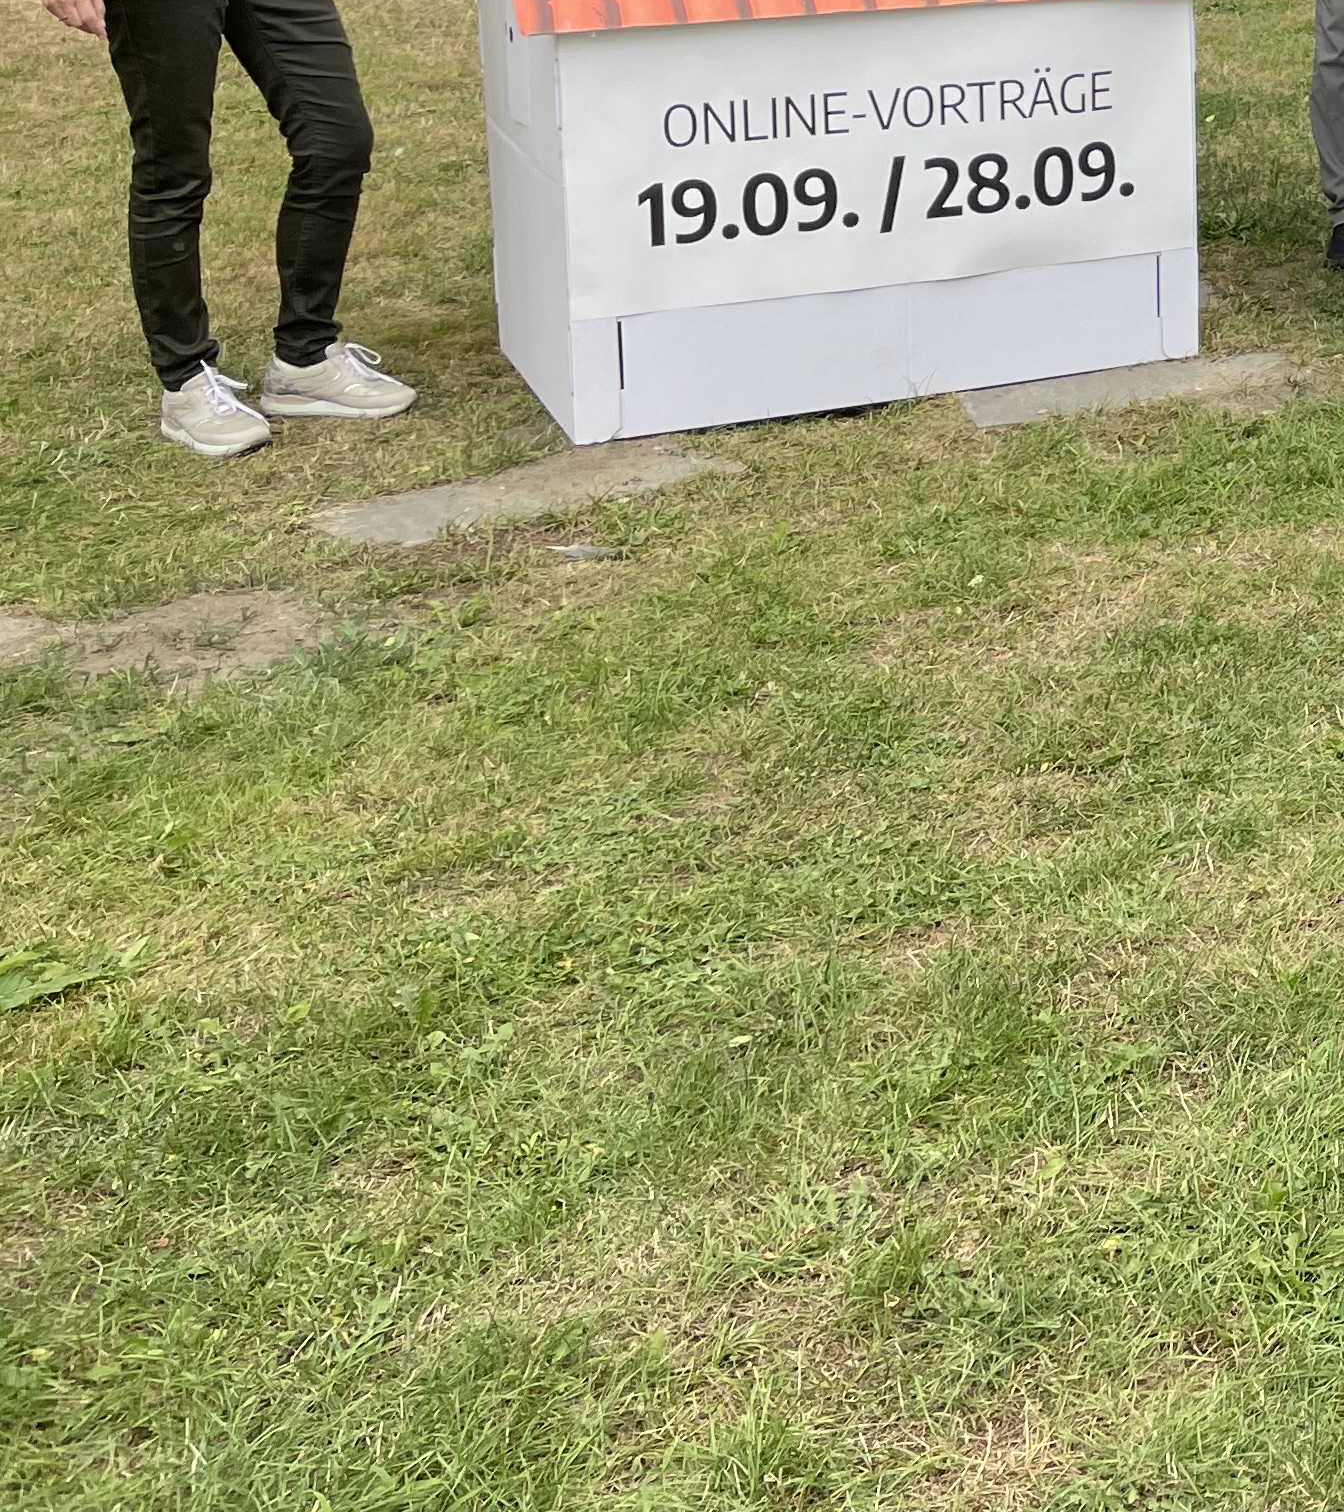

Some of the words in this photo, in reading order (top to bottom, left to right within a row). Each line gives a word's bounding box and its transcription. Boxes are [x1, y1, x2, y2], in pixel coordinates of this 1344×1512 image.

[663, 66, 1114, 148] ONLINE-VORTRÄGE
[638, 168, 860, 246] 19.09.
[879, 156, 906, 234] /
[925, 141, 1135, 221] 28.09.
